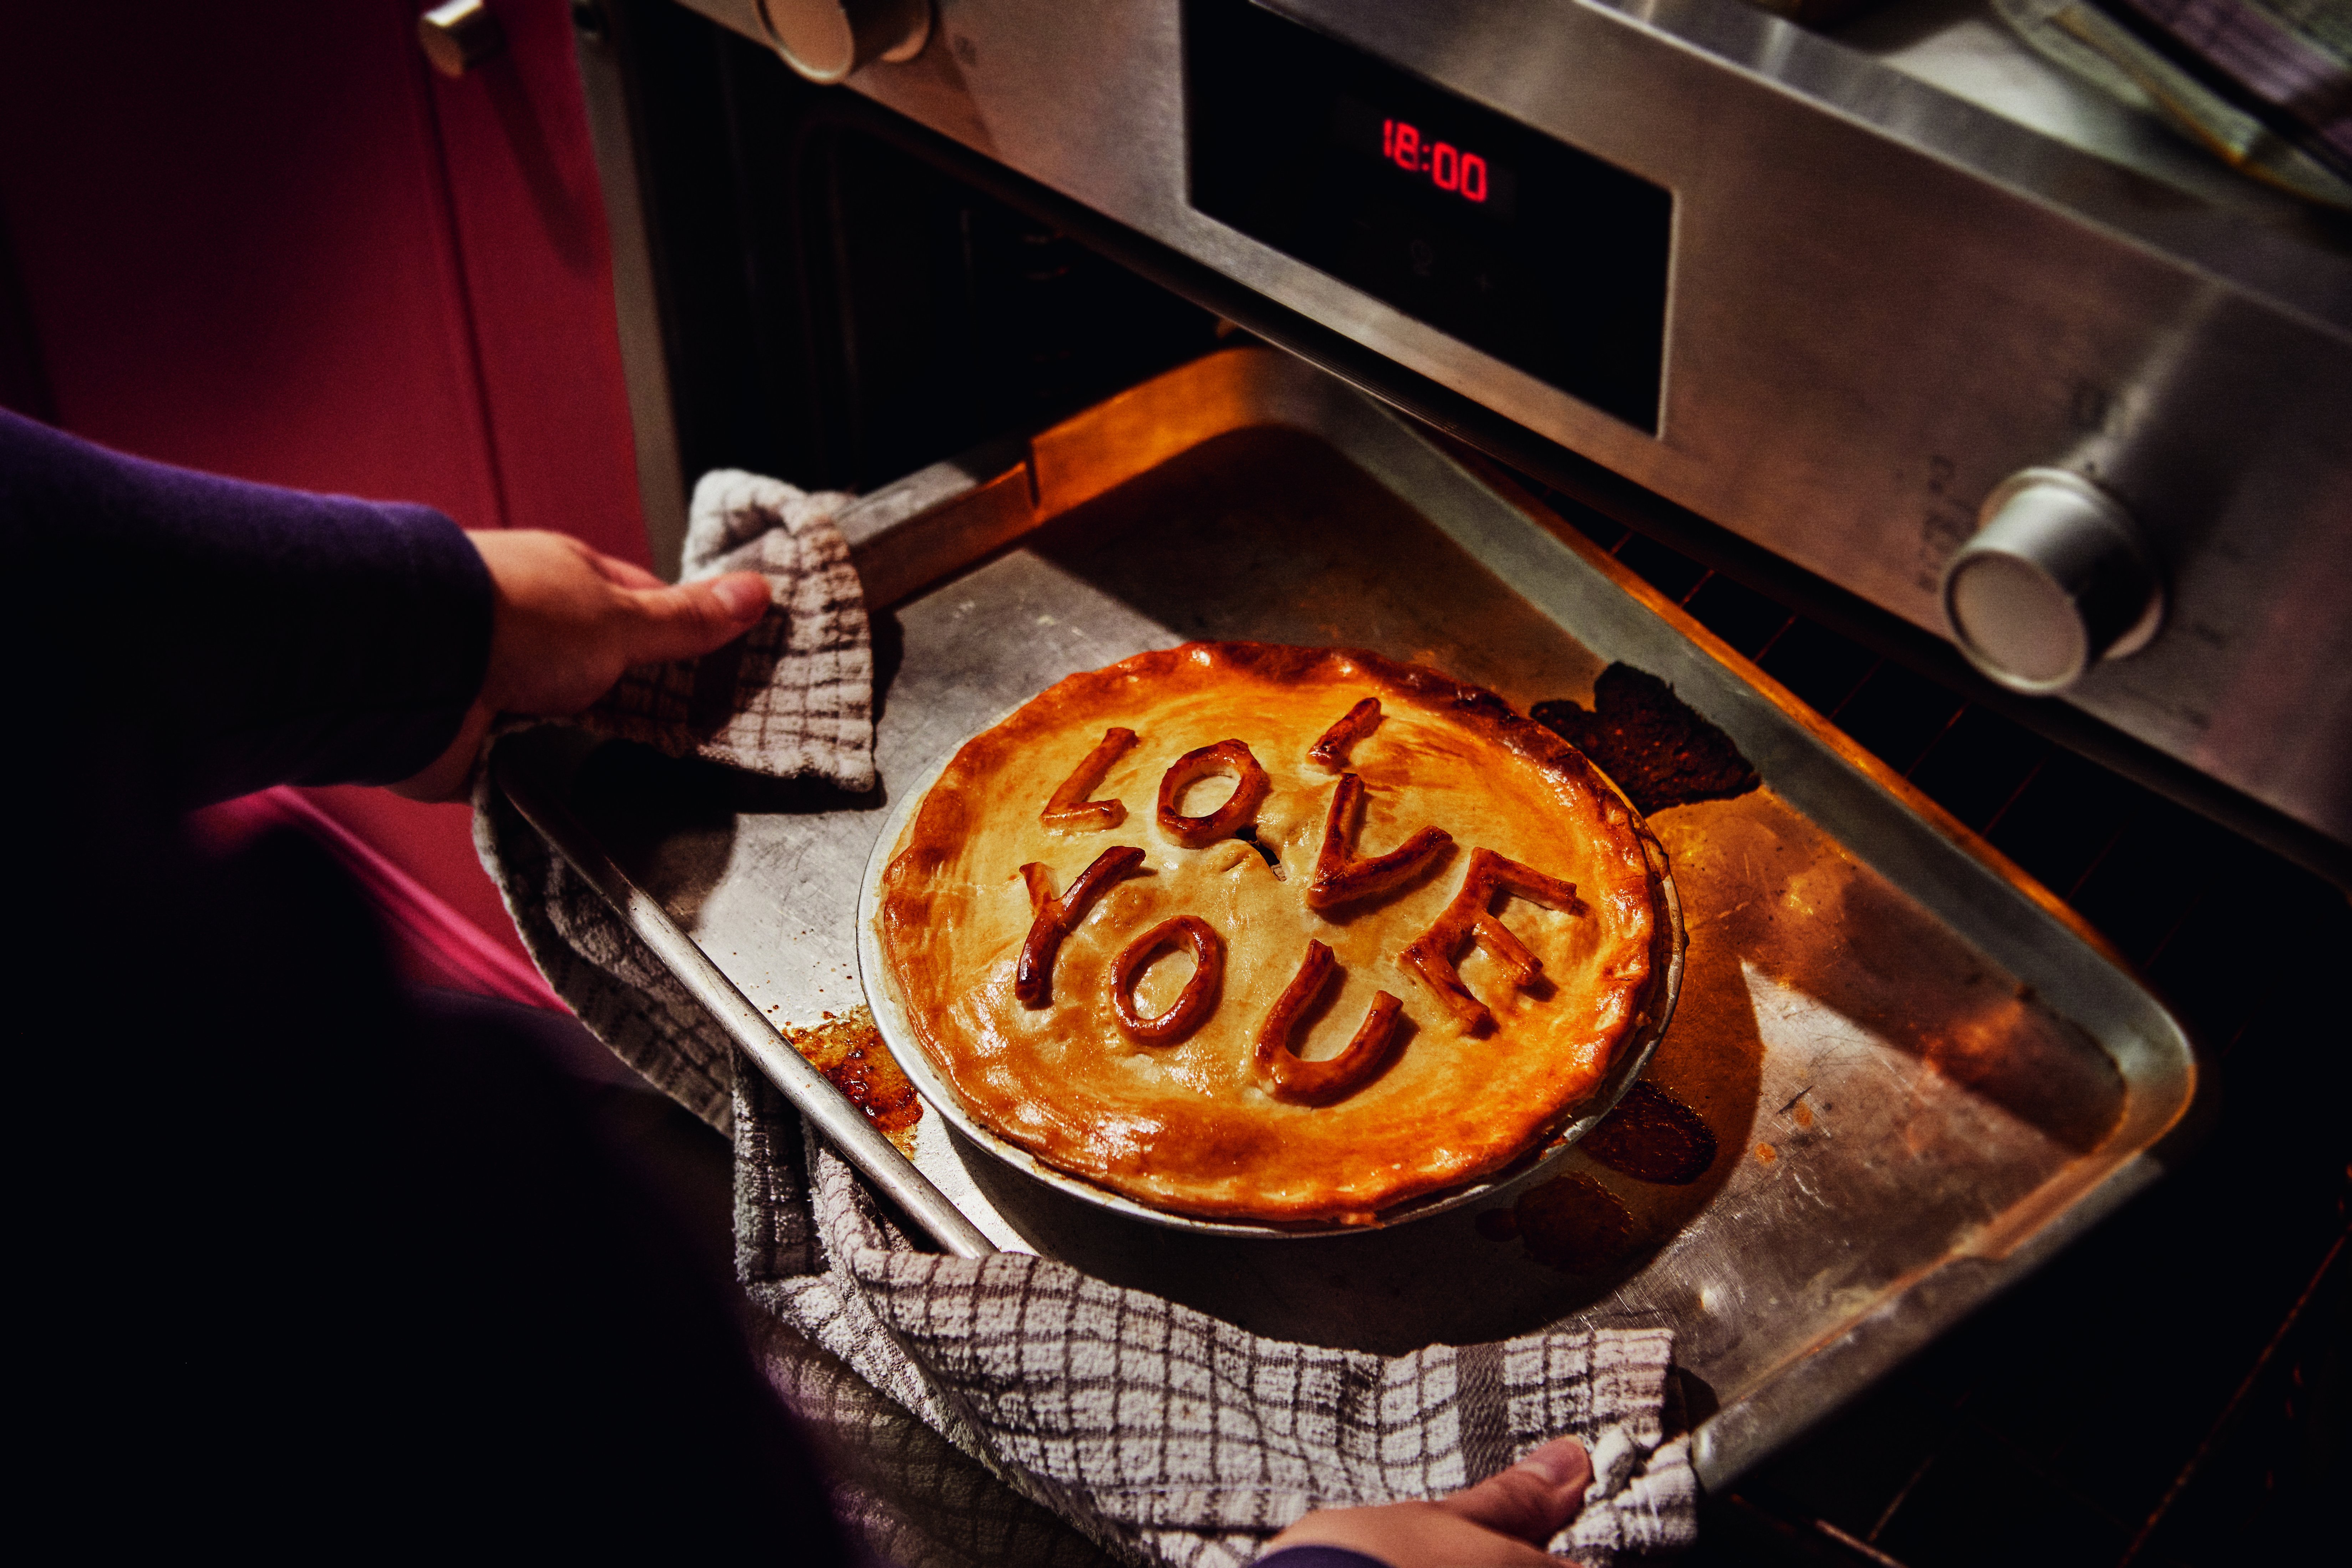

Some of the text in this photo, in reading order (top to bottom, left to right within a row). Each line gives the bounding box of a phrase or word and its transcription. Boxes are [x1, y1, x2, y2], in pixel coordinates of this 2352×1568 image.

[1382, 118, 1488, 203] 18:00
[1015, 845, 1404, 1105] YOU
[1040, 726, 1578, 1033] LOVE
